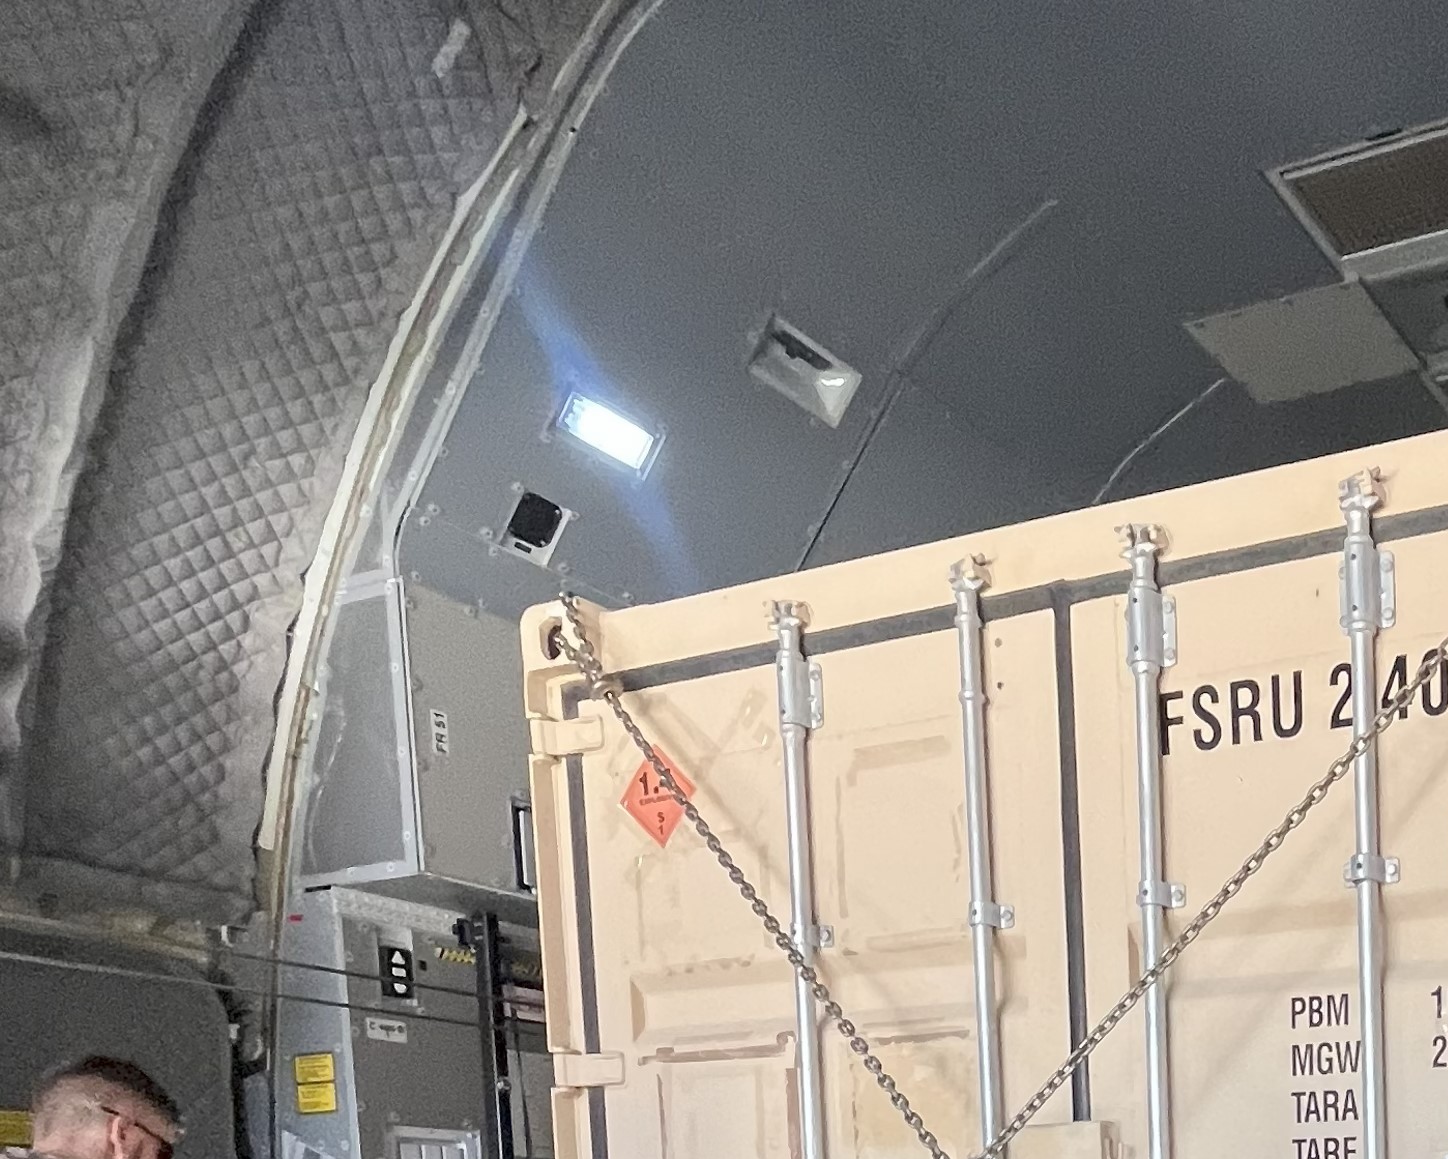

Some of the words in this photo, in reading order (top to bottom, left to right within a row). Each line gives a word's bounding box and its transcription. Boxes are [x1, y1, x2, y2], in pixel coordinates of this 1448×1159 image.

[1160, 670, 1303, 756] FSRU
[657, 811, 665, 823] S
[657, 824, 664, 835] 1
[1291, 993, 1349, 1029] PBM
[1291, 1040, 1361, 1077] MGW
[1290, 1089, 1359, 1124] TARA
